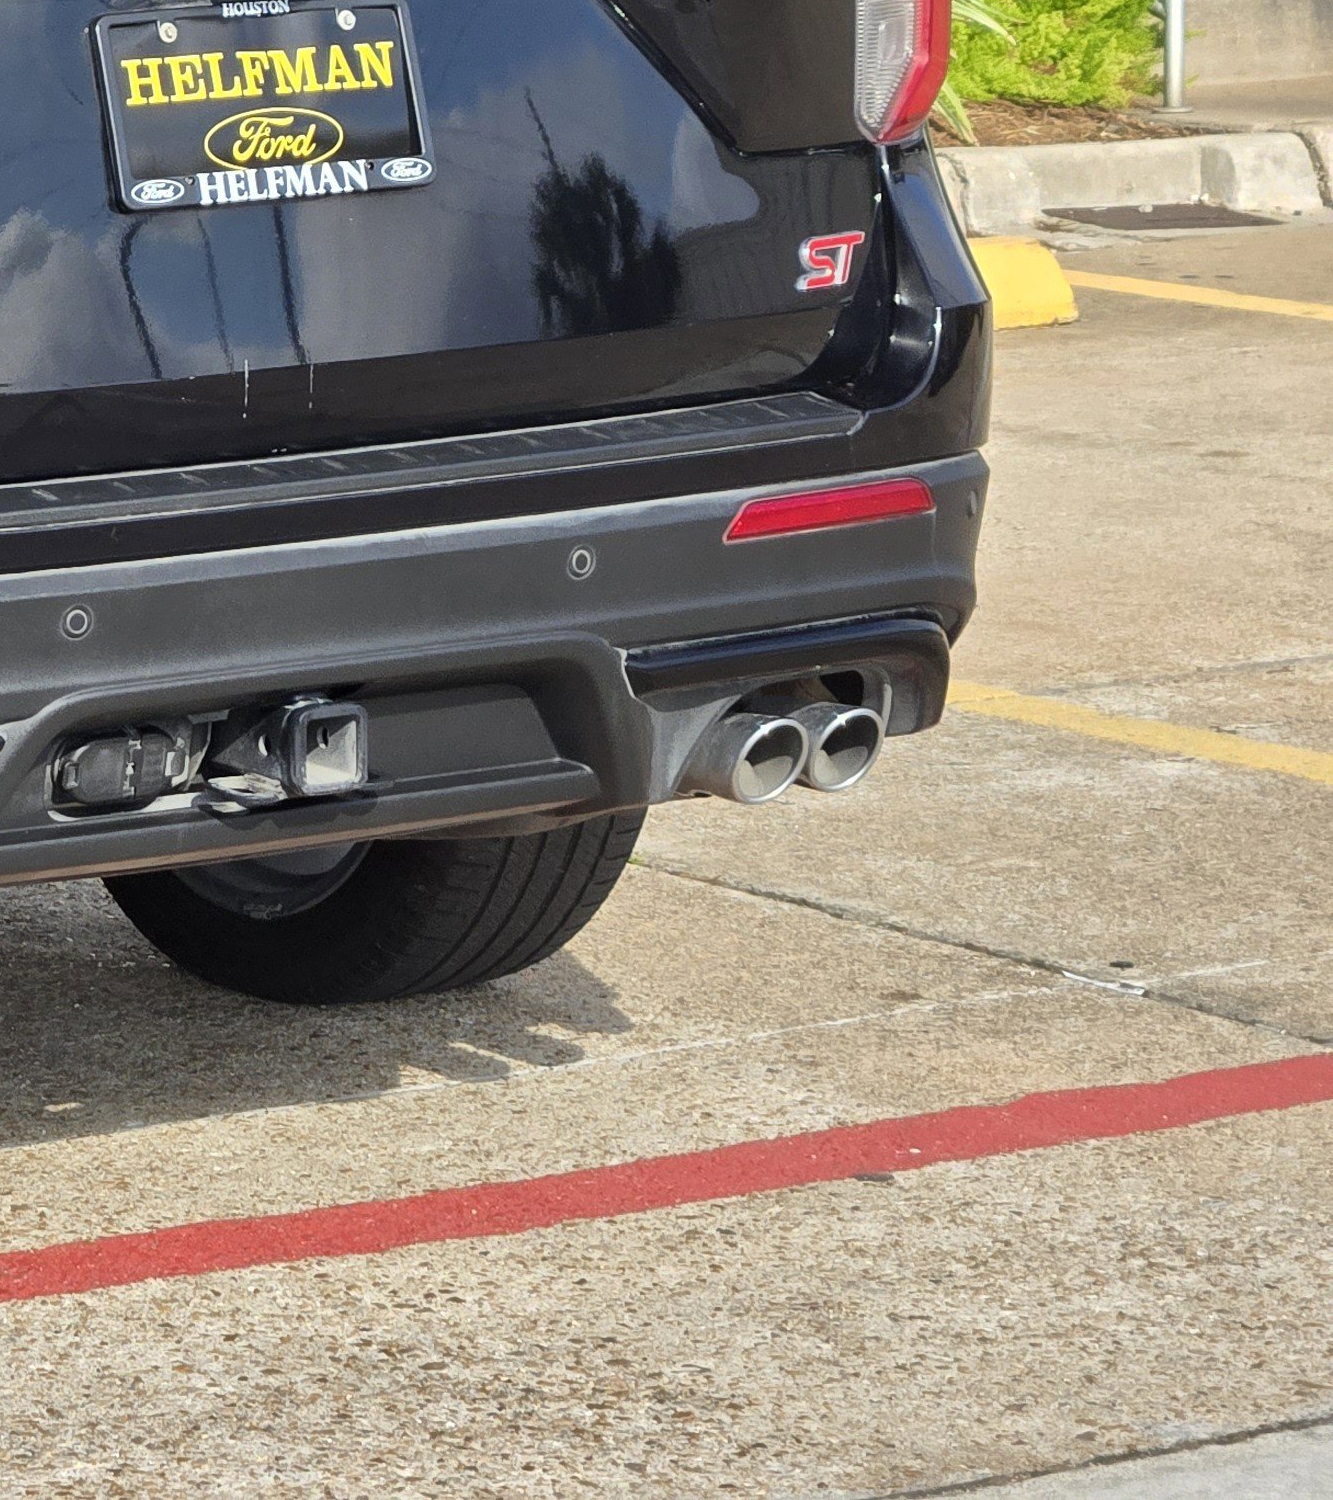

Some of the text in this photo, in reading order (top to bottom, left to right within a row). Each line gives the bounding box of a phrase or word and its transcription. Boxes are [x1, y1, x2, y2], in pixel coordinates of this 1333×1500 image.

[221, 0, 290, 18] HOUSTON
[120, 41, 395, 107] HELFMAN
[232, 115, 317, 162] Ford
[141, 183, 182, 201] Ford
[196, 158, 369, 205] HELFMAN
[390, 161, 423, 179] Ford
[794, 230, 865, 292] ST
